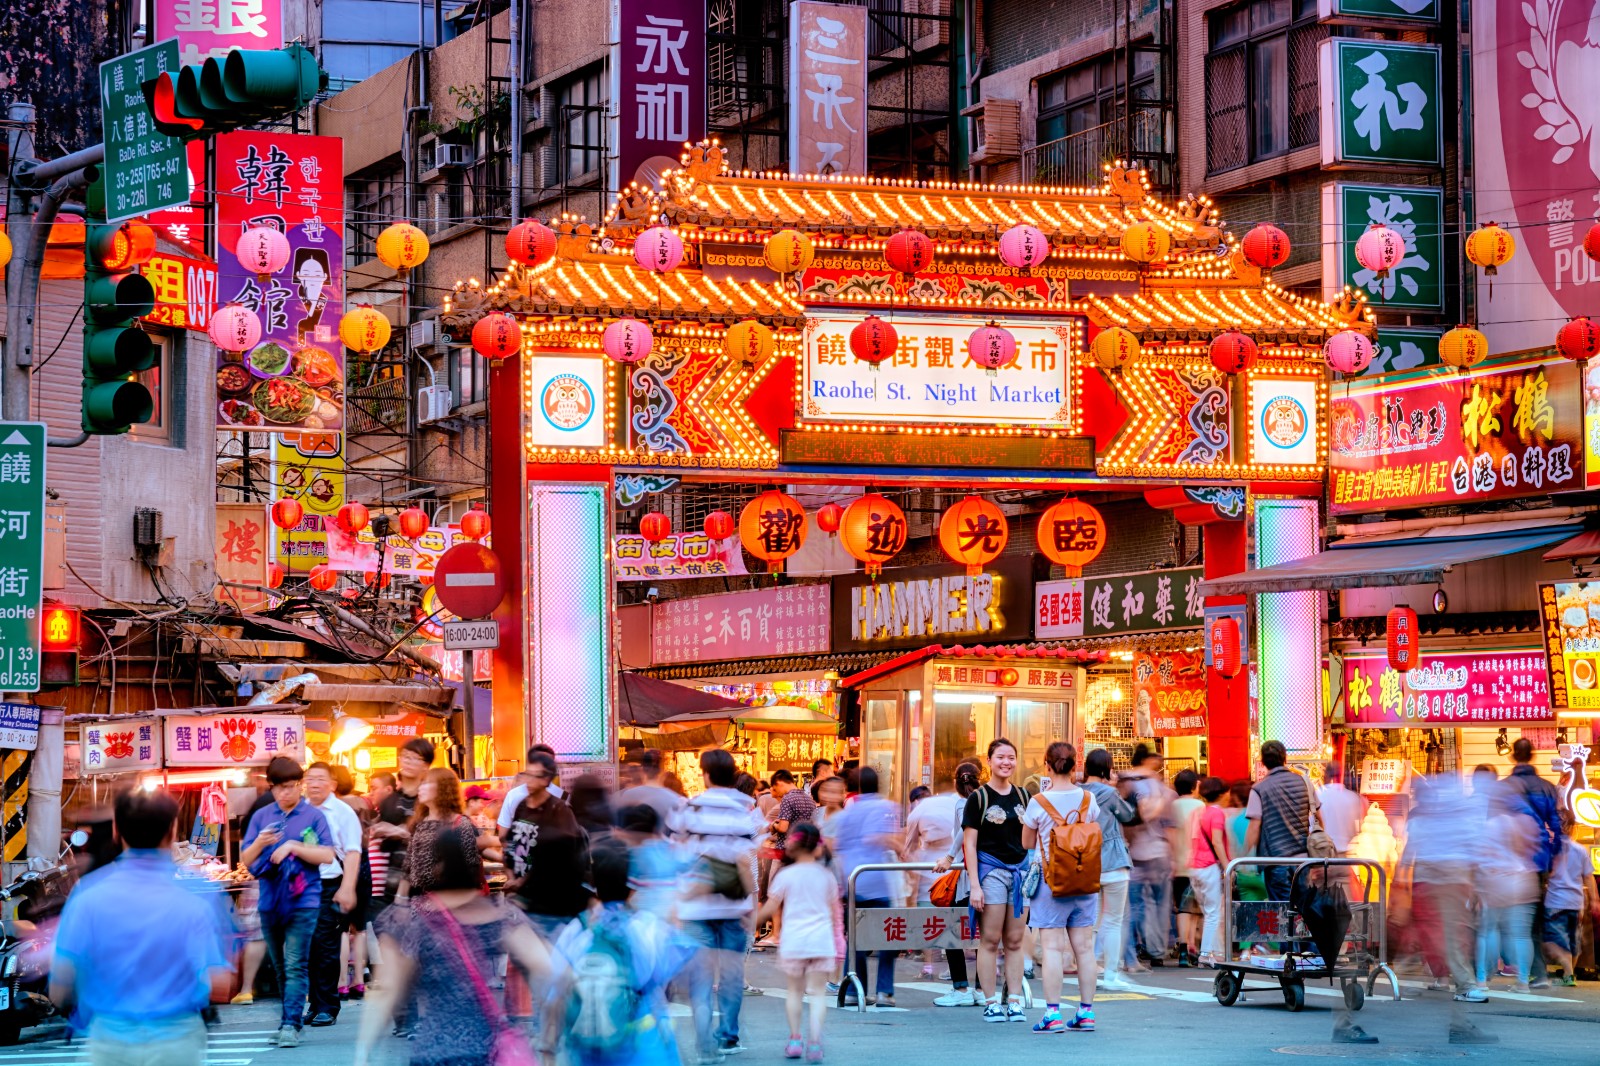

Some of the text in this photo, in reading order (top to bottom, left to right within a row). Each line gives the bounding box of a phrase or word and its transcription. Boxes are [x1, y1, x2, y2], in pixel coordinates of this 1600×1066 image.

[113, 50, 168, 92] 饒河街
[635, 14, 690, 142] 永和
[1351, 50, 1428, 151] 和
[111, 111, 156, 143] 八德路
[119, 136, 172, 163] BaDe Rd. Sec. 4
[116, 167, 144, 189] 33-255
[146, 157, 180, 181] 765-847
[117, 188, 144, 211] 30-226
[157, 182, 172, 201] 746
[298, 156, 326, 243] 한국관
[659, 232, 668, 266] 天上聖母
[142, 258, 187, 306] 租
[187, 265, 219, 327] 097
[624, 325, 634, 357] 天上聖母
[872, 324, 881, 356] 天上聖母
[812, 379, 1062, 405] Raohe St. Night Market
[1462, 371, 1555, 448] 松鶴
[1453, 445, 1573, 493] 台港日料理
[0, 451, 31, 597] 饒河街
[757, 508, 1098, 557] 歡 迎 光 臨
[221, 518, 262, 565] 樓
[281, 541, 329, 556] 流行精
[617, 535, 710, 559] 街夜市
[851, 574, 1001, 641] HAMMER
[1039, 591, 1083, 627] 各國名藥
[445, 627, 496, 642] 16:00-24:00
[702, 603, 773, 646] 三禾百貨
[938, 665, 1074, 688] 媽祖廟口 服務台
[1348, 666, 1405, 719] 松鶴
[1406, 693, 1468, 720] 台港日料理
[15, 721, 39, 729] Crossing
[176, 726, 212, 752] 蟹腳
